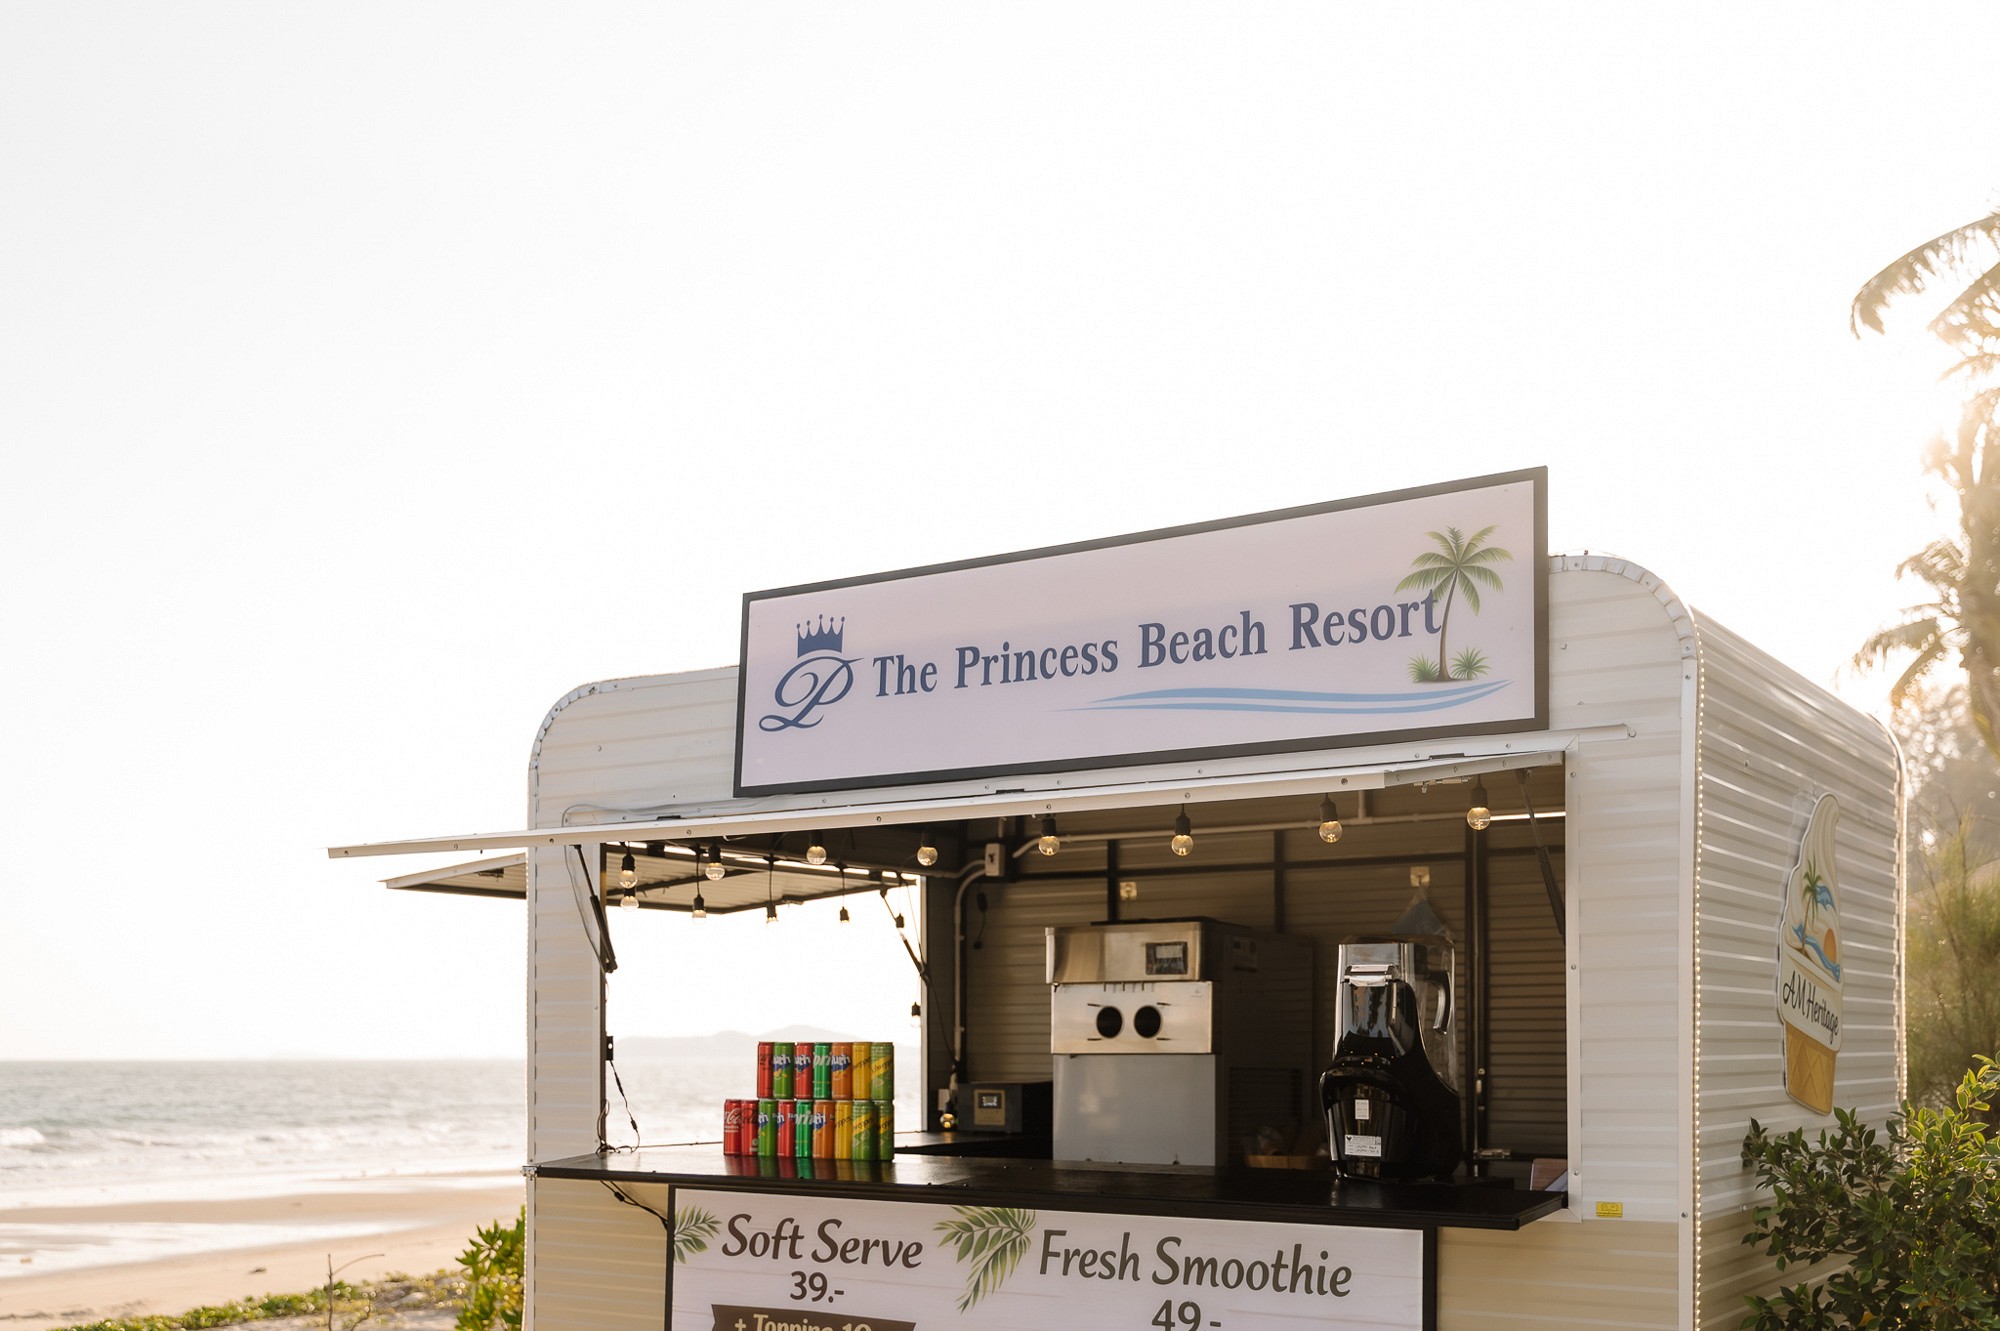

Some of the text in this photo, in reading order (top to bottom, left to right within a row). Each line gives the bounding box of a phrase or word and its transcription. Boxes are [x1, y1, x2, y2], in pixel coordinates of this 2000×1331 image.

[872, 588, 1442, 697] The Princess Beach Resort
[1782, 970, 1840, 1045] AM Heritage
[721, 1213, 924, 1268] Soft Serve
[1039, 1229, 1353, 1298] Fresh Smoothie
[789, 1270, 845, 1304] 39.-
[752, 1313, 834, 1331] Toin
[1151, 1299, 1222, 1331] 49-
